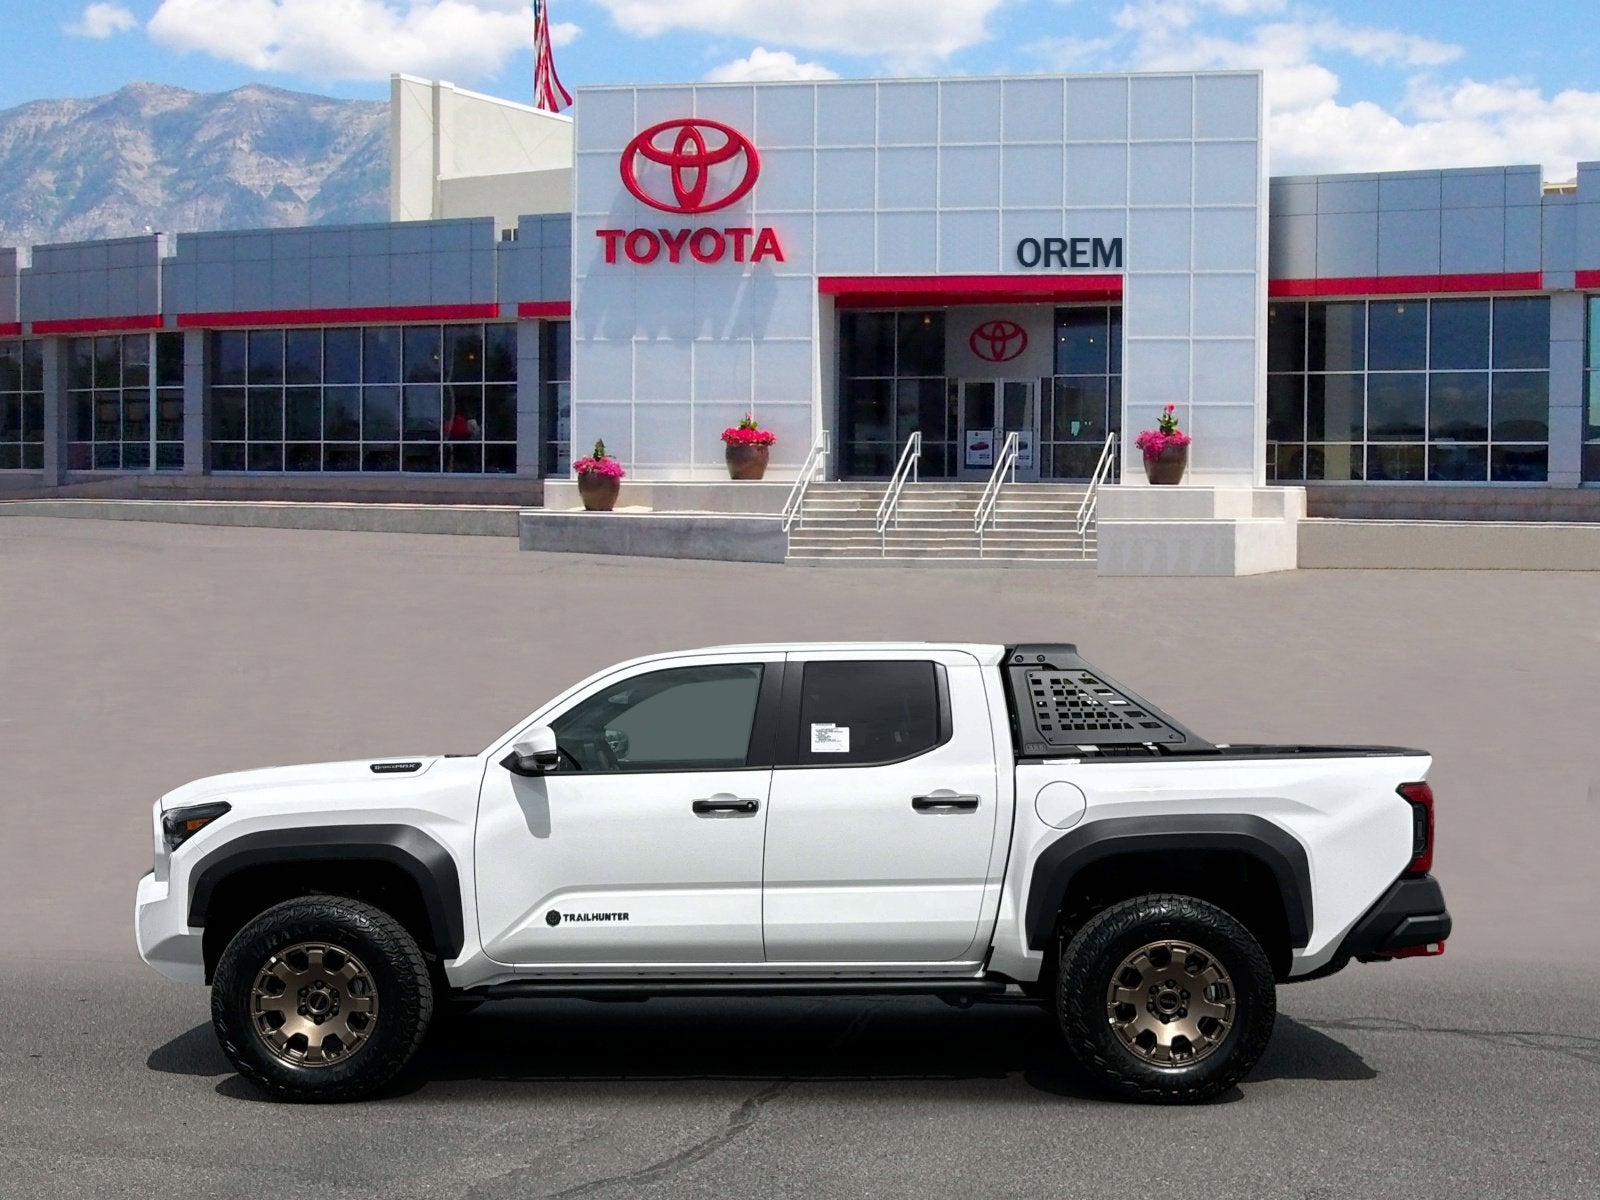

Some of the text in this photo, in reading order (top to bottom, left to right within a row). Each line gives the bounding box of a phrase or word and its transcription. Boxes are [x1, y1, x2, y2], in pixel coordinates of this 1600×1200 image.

[596, 227, 784, 264] TOYOTA
[1017, 237, 1122, 267] OREM
[563, 912, 630, 922] TRAILHUNTER
